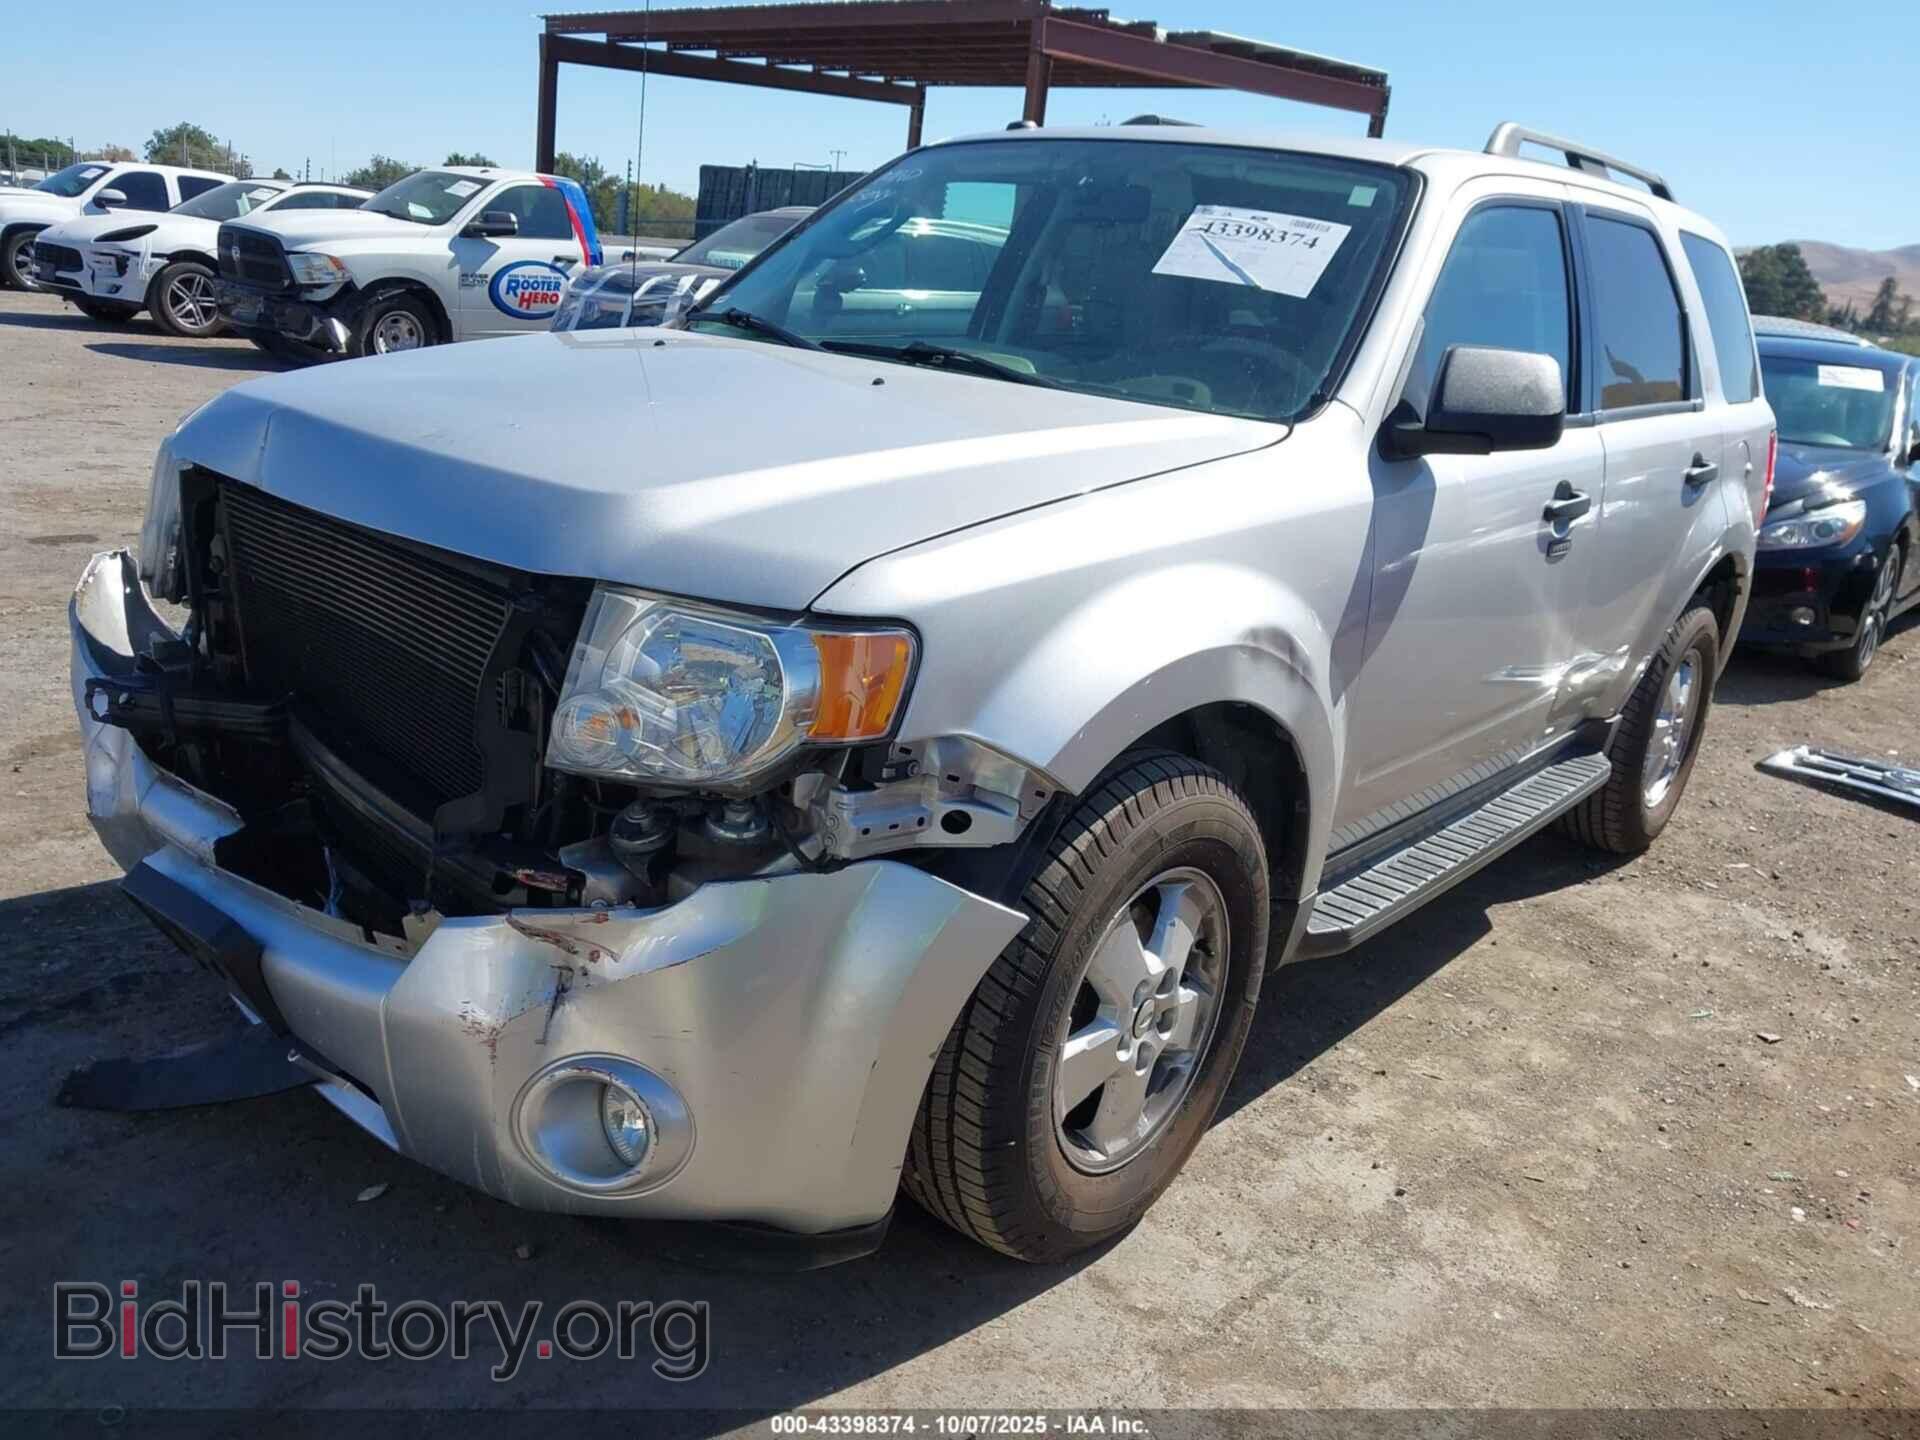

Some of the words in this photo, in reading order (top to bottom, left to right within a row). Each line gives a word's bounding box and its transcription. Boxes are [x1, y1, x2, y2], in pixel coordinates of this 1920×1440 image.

[1199, 221, 1320, 249] 43398374
[505, 279, 561, 297] ROOTER
[518, 291, 560, 310] HERO
